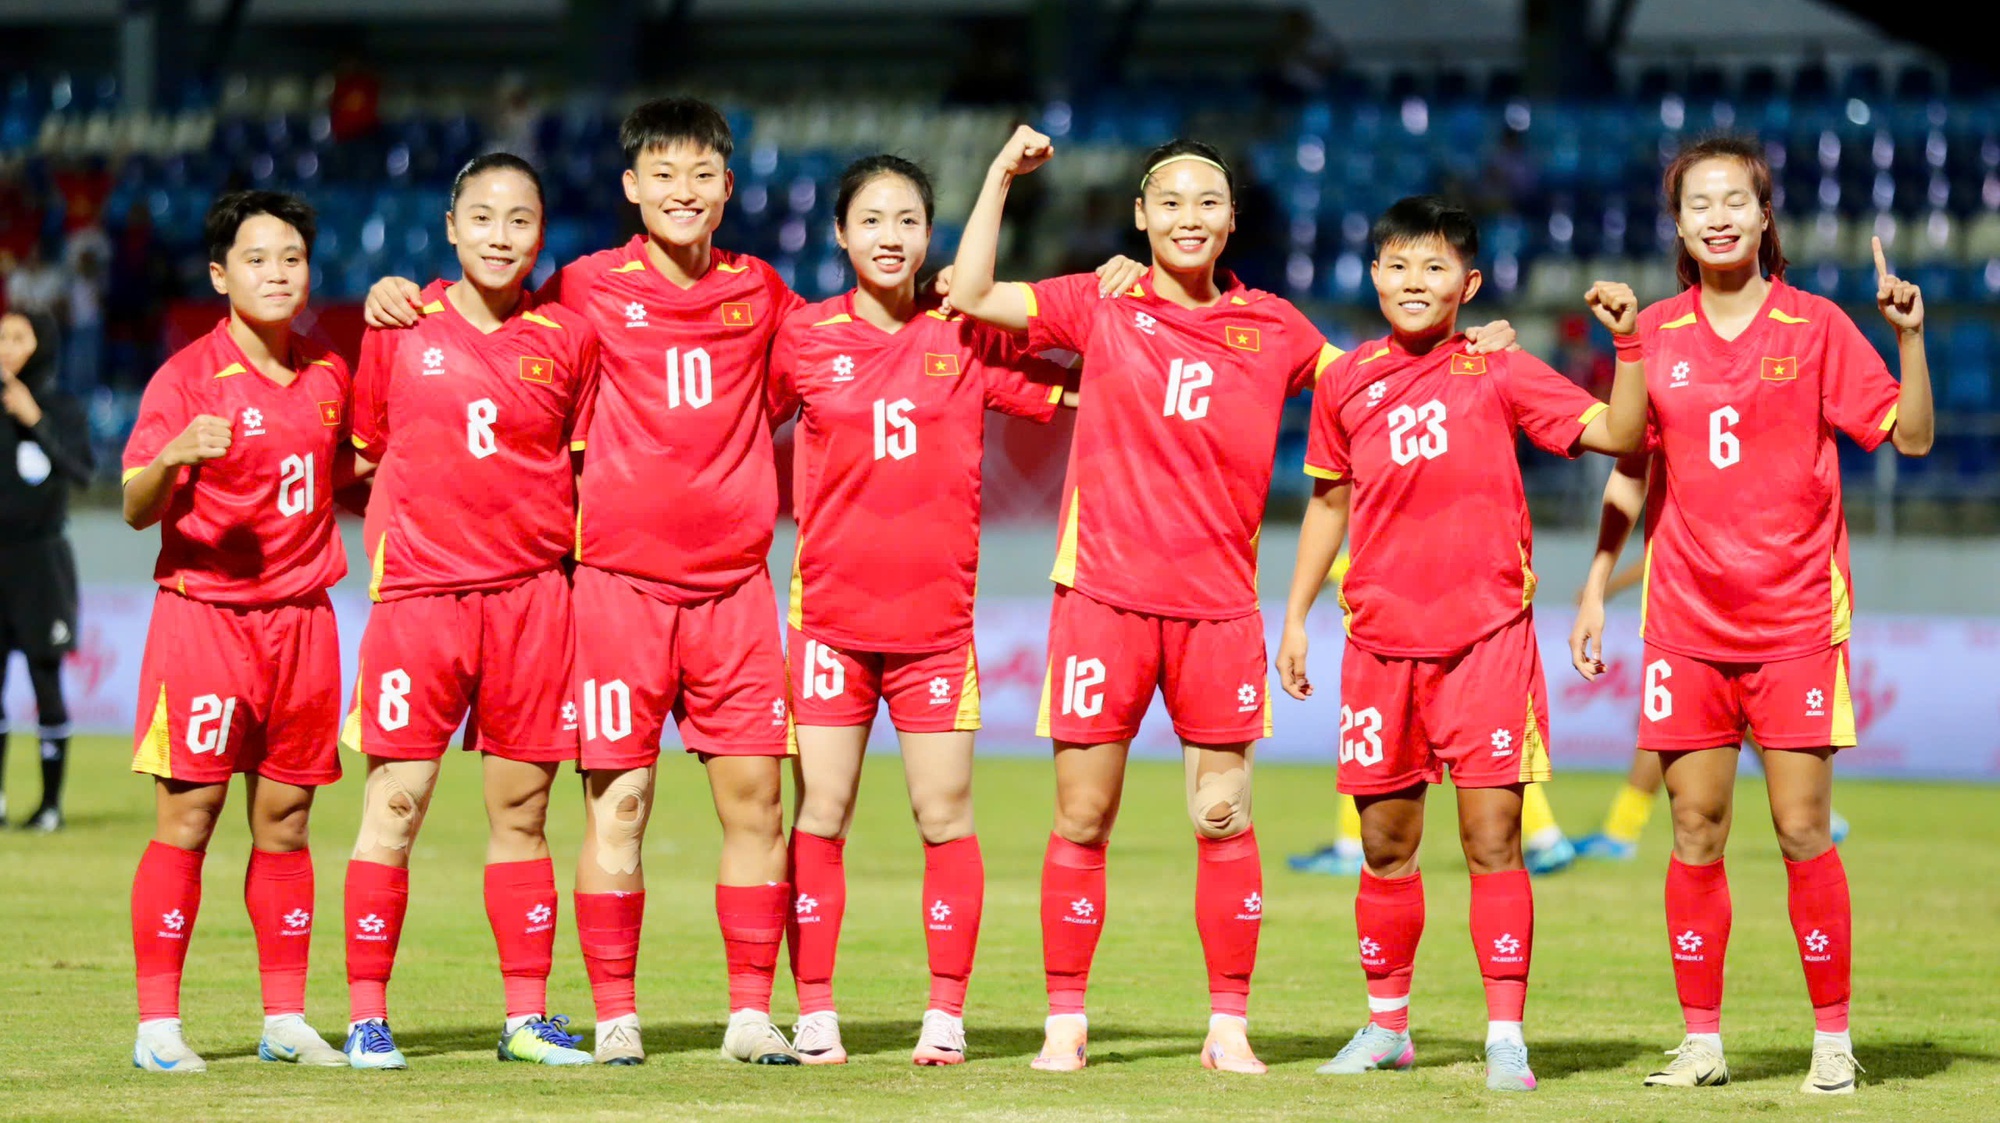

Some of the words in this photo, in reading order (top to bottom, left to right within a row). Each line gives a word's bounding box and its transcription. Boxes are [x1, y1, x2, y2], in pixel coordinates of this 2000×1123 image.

[667, 347, 712, 409] 10
[1164, 358, 1213, 420] 12
[468, 398, 499, 459] 8
[873, 398, 916, 460] 15
[1388, 402, 1447, 464] 23
[1710, 406, 1740, 469] 6
[278, 457, 314, 517] 21
[379, 669, 410, 731] 8
[803, 640, 844, 700] 15
[1062, 656, 1105, 718] 12
[1644, 660, 1673, 722] 6
[187, 694, 235, 755] 21
[584, 679, 631, 741] 10
[1338, 704, 1384, 766] 23
